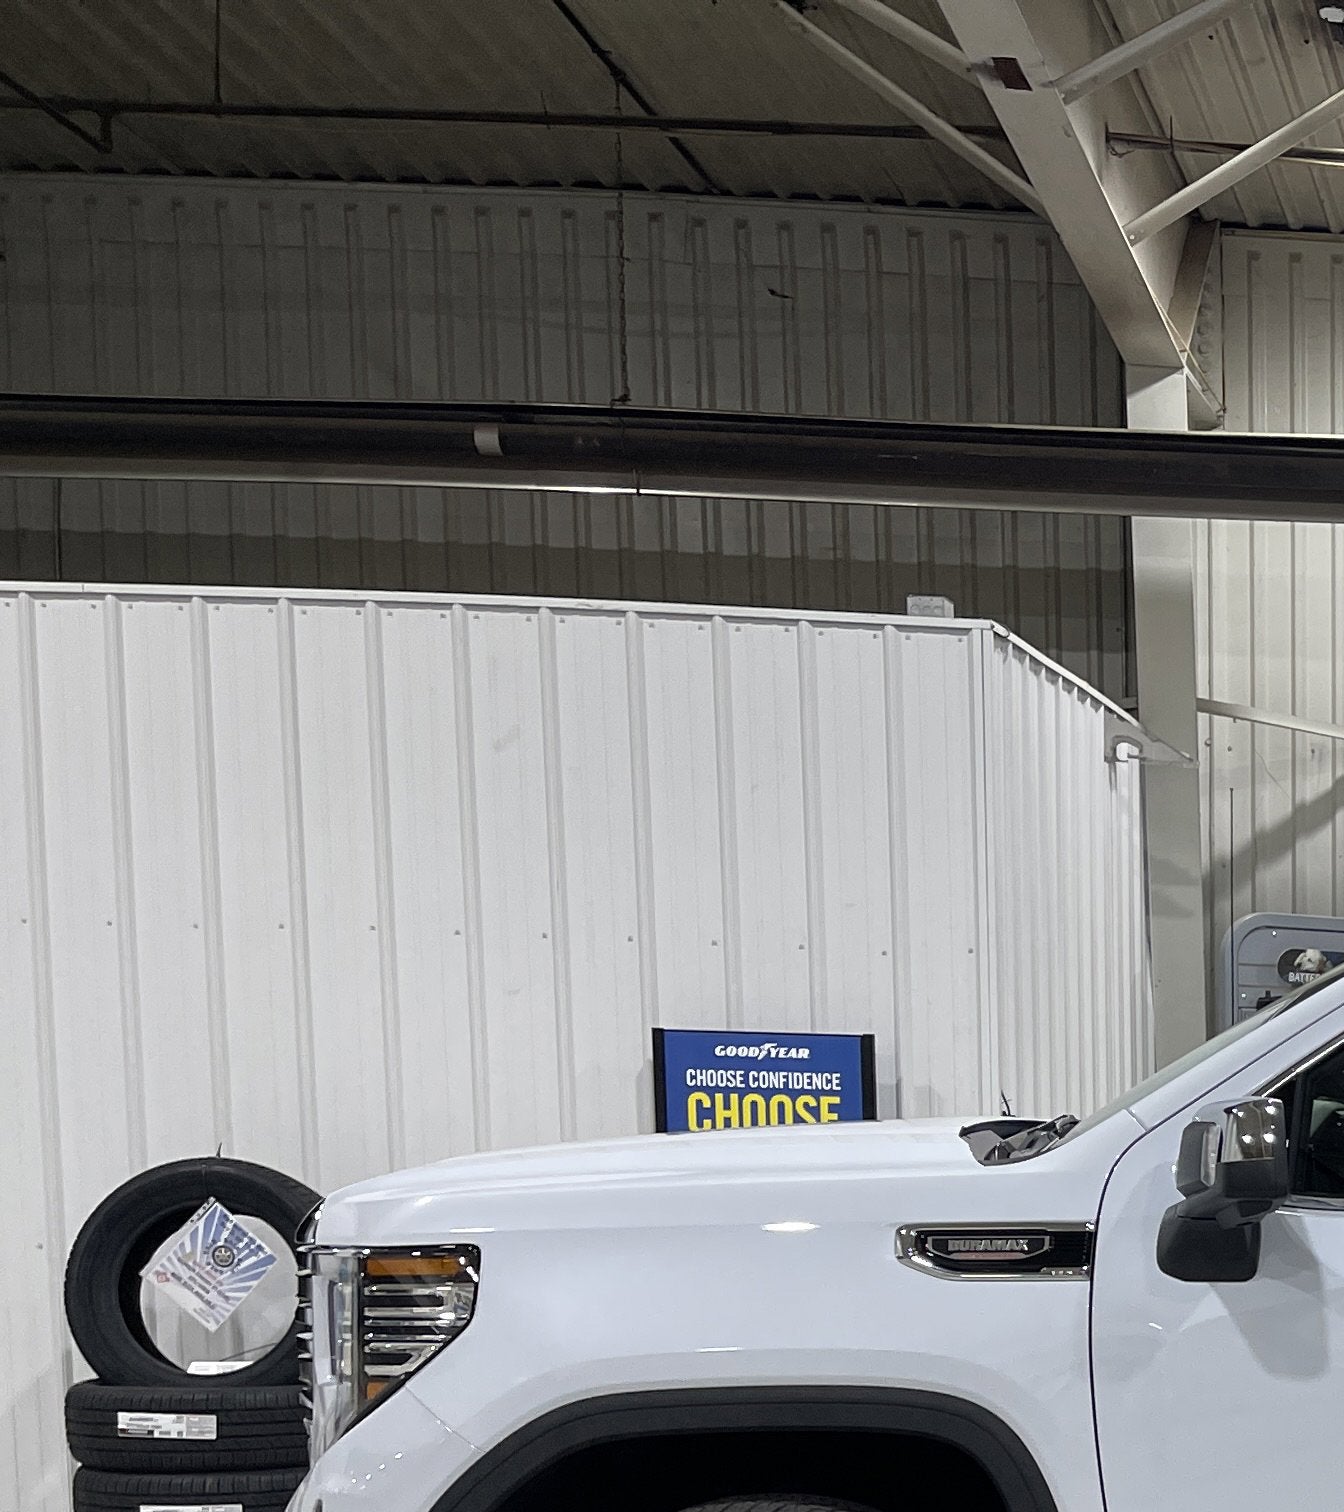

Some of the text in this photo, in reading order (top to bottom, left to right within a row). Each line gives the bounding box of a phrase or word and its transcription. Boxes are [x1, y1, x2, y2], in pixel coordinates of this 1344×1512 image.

[685, 1068, 842, 1091] CHOOSE CONFIDENCE
[687, 1091, 842, 1133] CHOOSE
